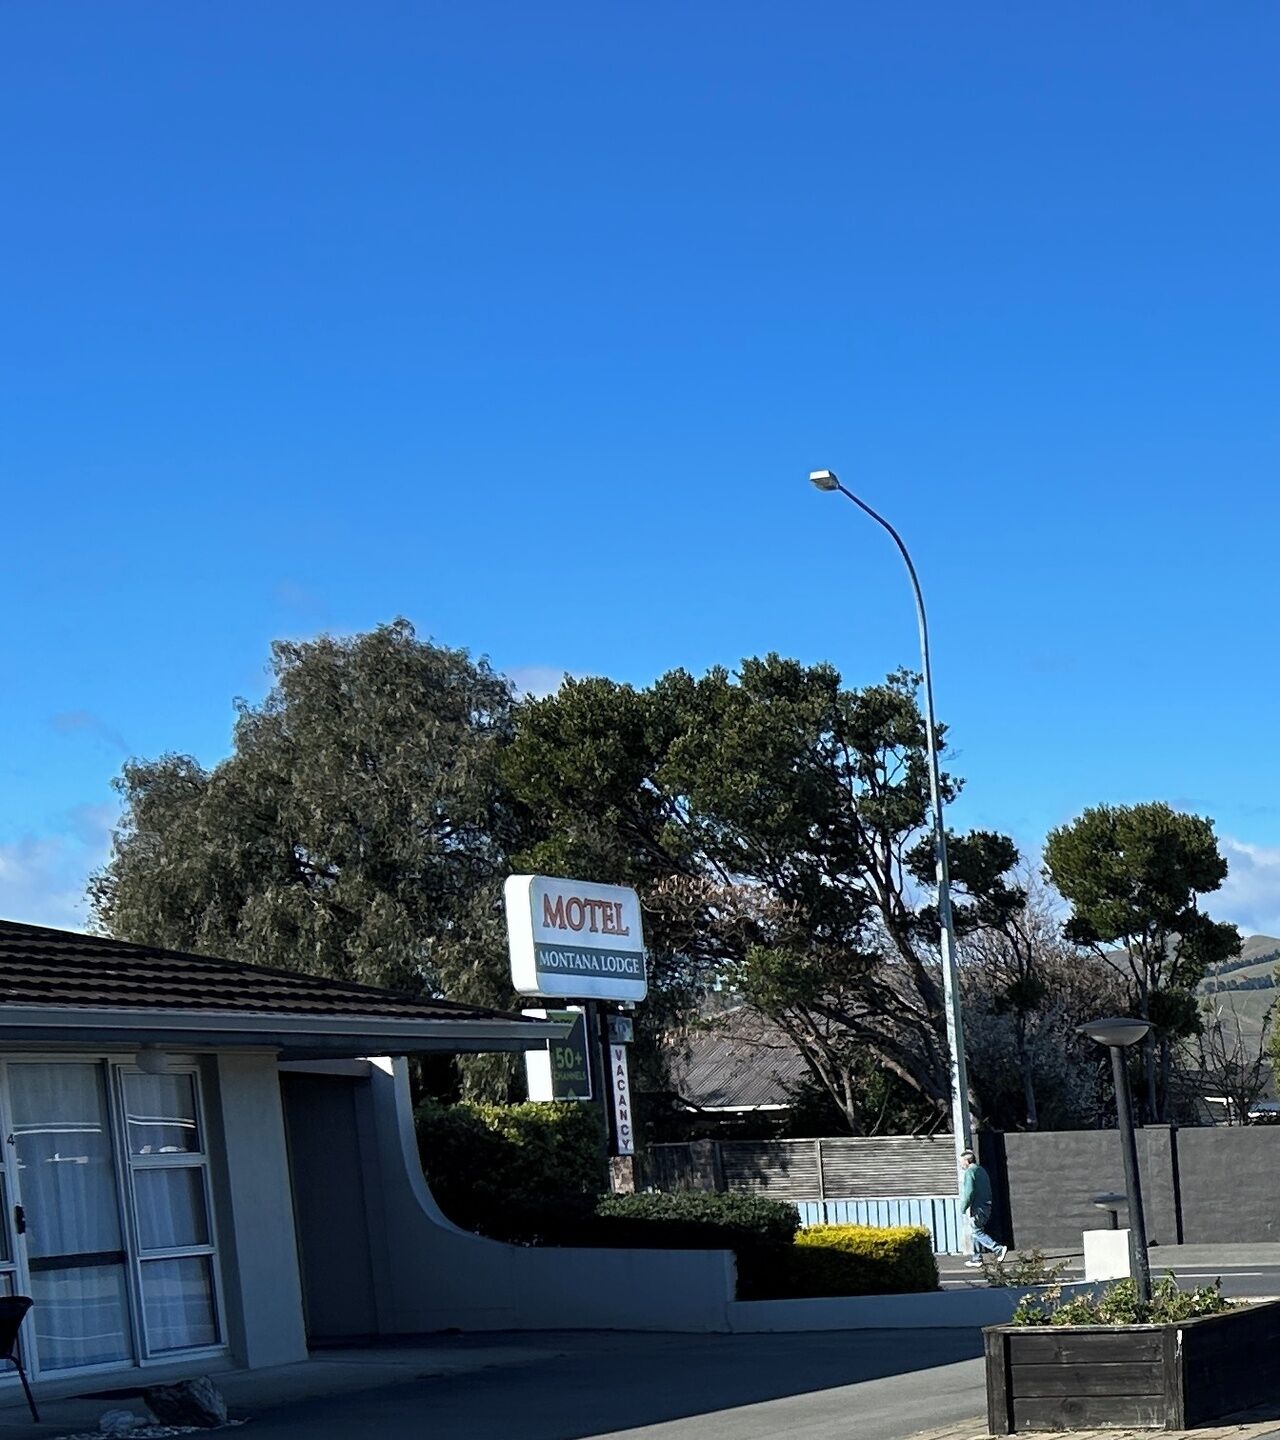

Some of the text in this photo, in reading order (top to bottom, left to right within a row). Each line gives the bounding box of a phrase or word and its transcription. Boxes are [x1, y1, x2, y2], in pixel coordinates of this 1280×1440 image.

[542, 893, 630, 936] MOTEL
[539, 950, 641, 974] MONTANA LODGE
[555, 1047, 583, 1069] 50+
[555, 1070, 586, 1081] CHANNELS
[615, 1050, 631, 1150] VACANCY
[7, 1134, 15, 1146] 4
